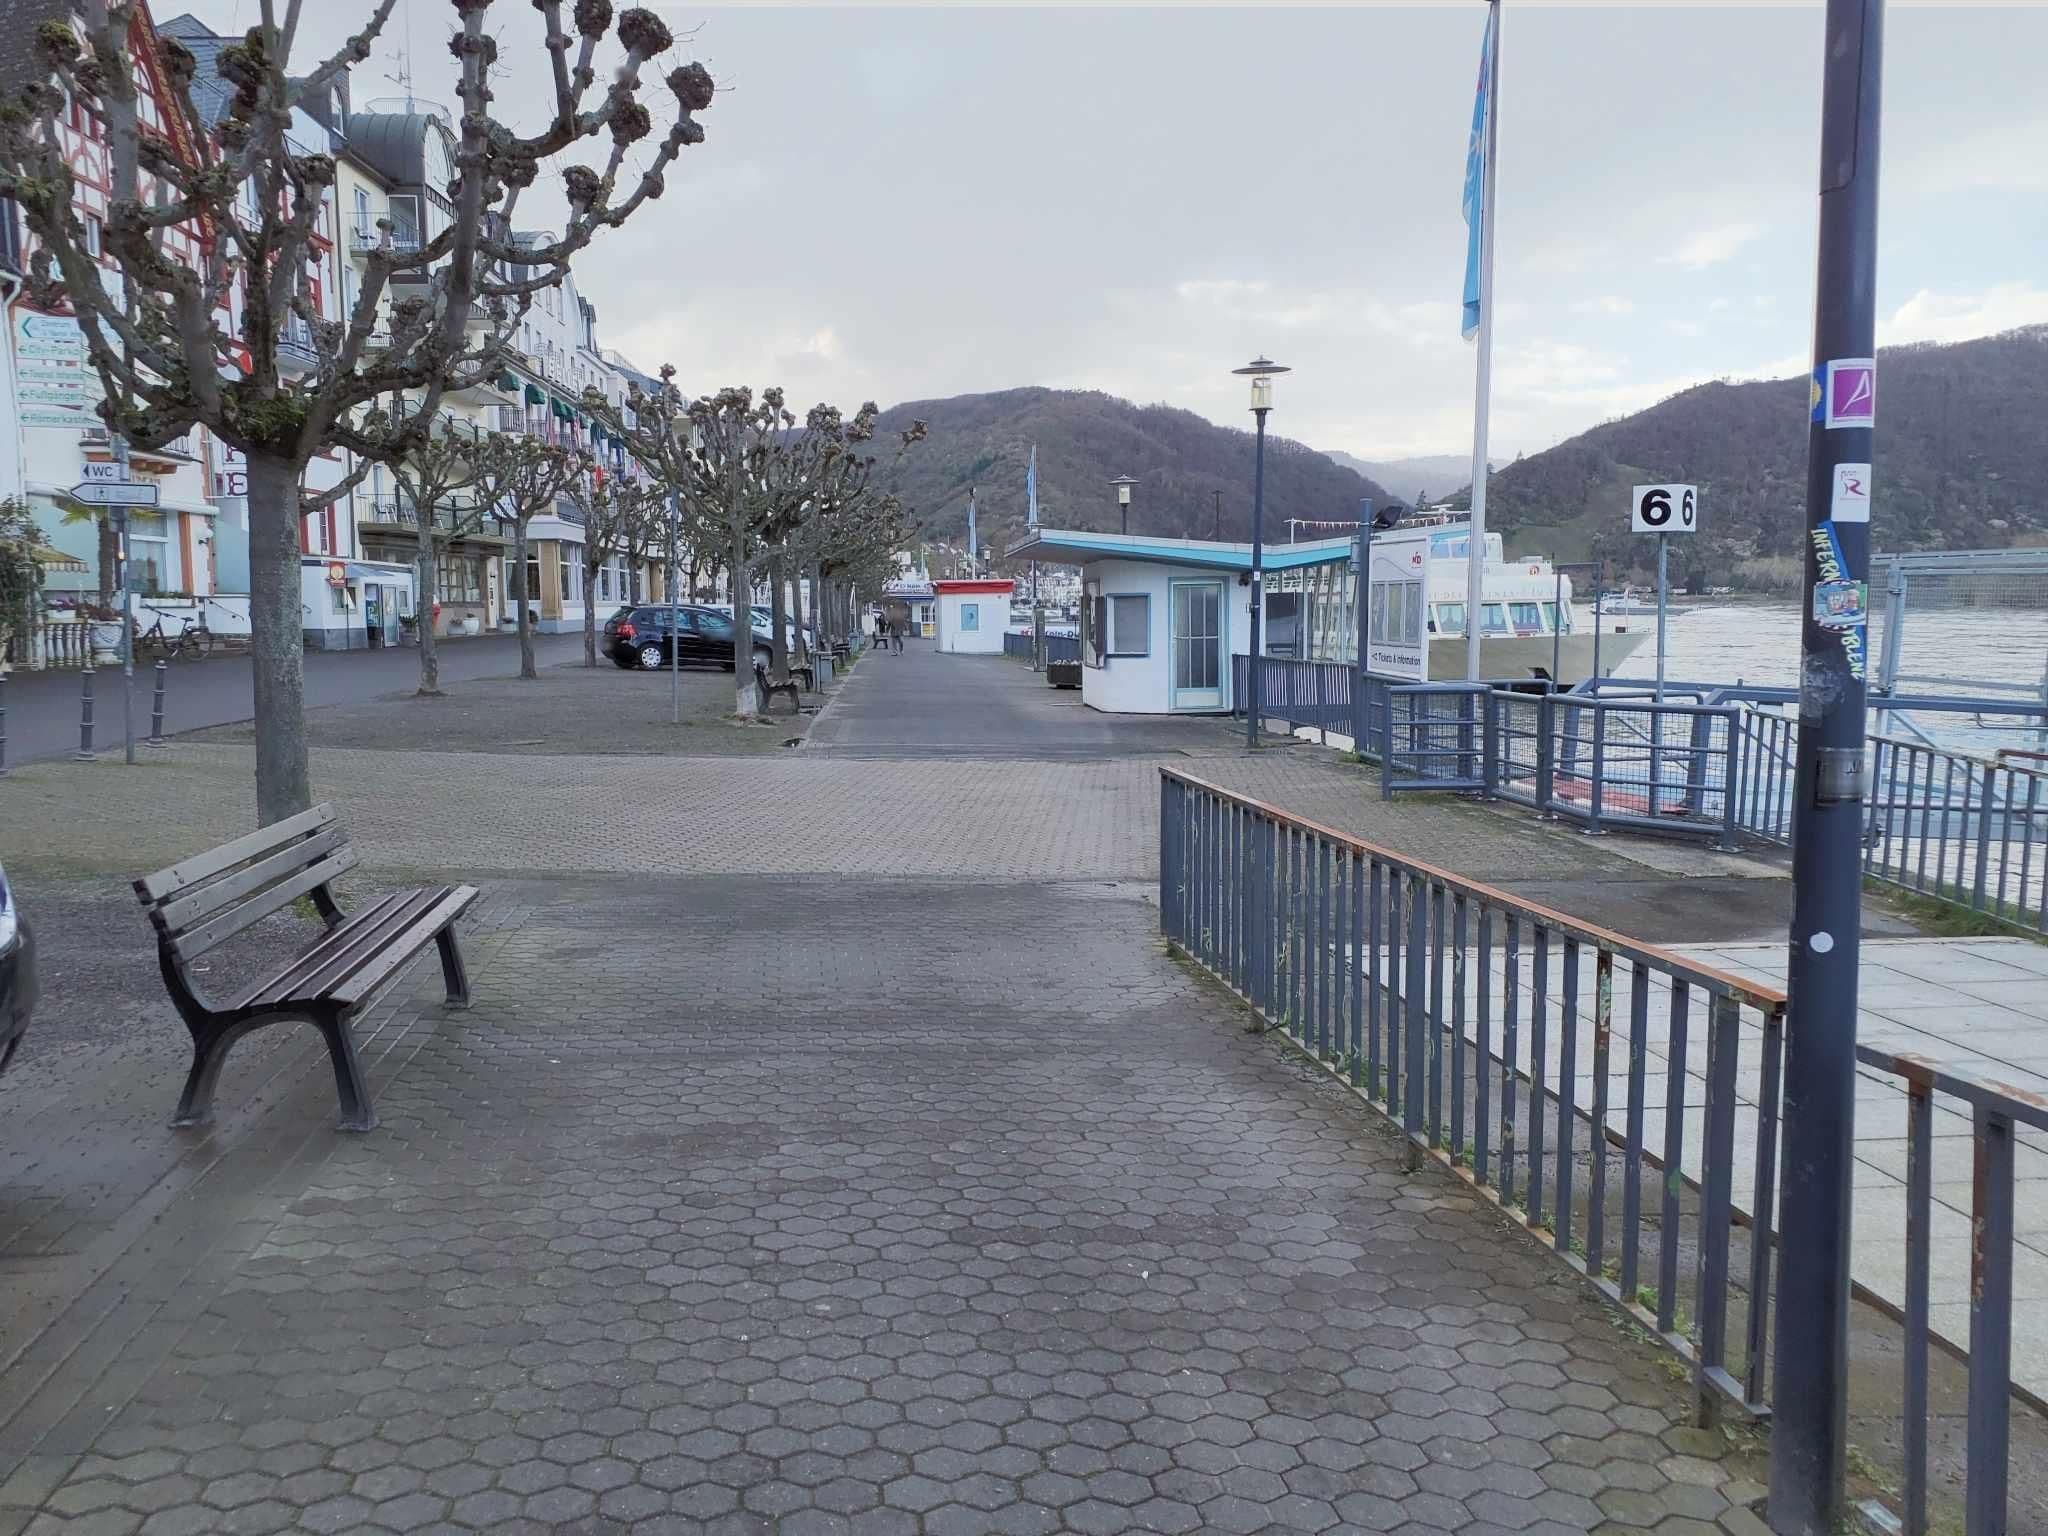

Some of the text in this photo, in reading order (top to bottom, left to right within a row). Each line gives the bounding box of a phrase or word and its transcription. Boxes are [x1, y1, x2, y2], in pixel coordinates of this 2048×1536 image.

[92, 466, 113, 477] WC
[1641, 489, 1672, 526] 6
[1682, 489, 1694, 526] 6
[1811, 527, 1841, 582] INFERN
